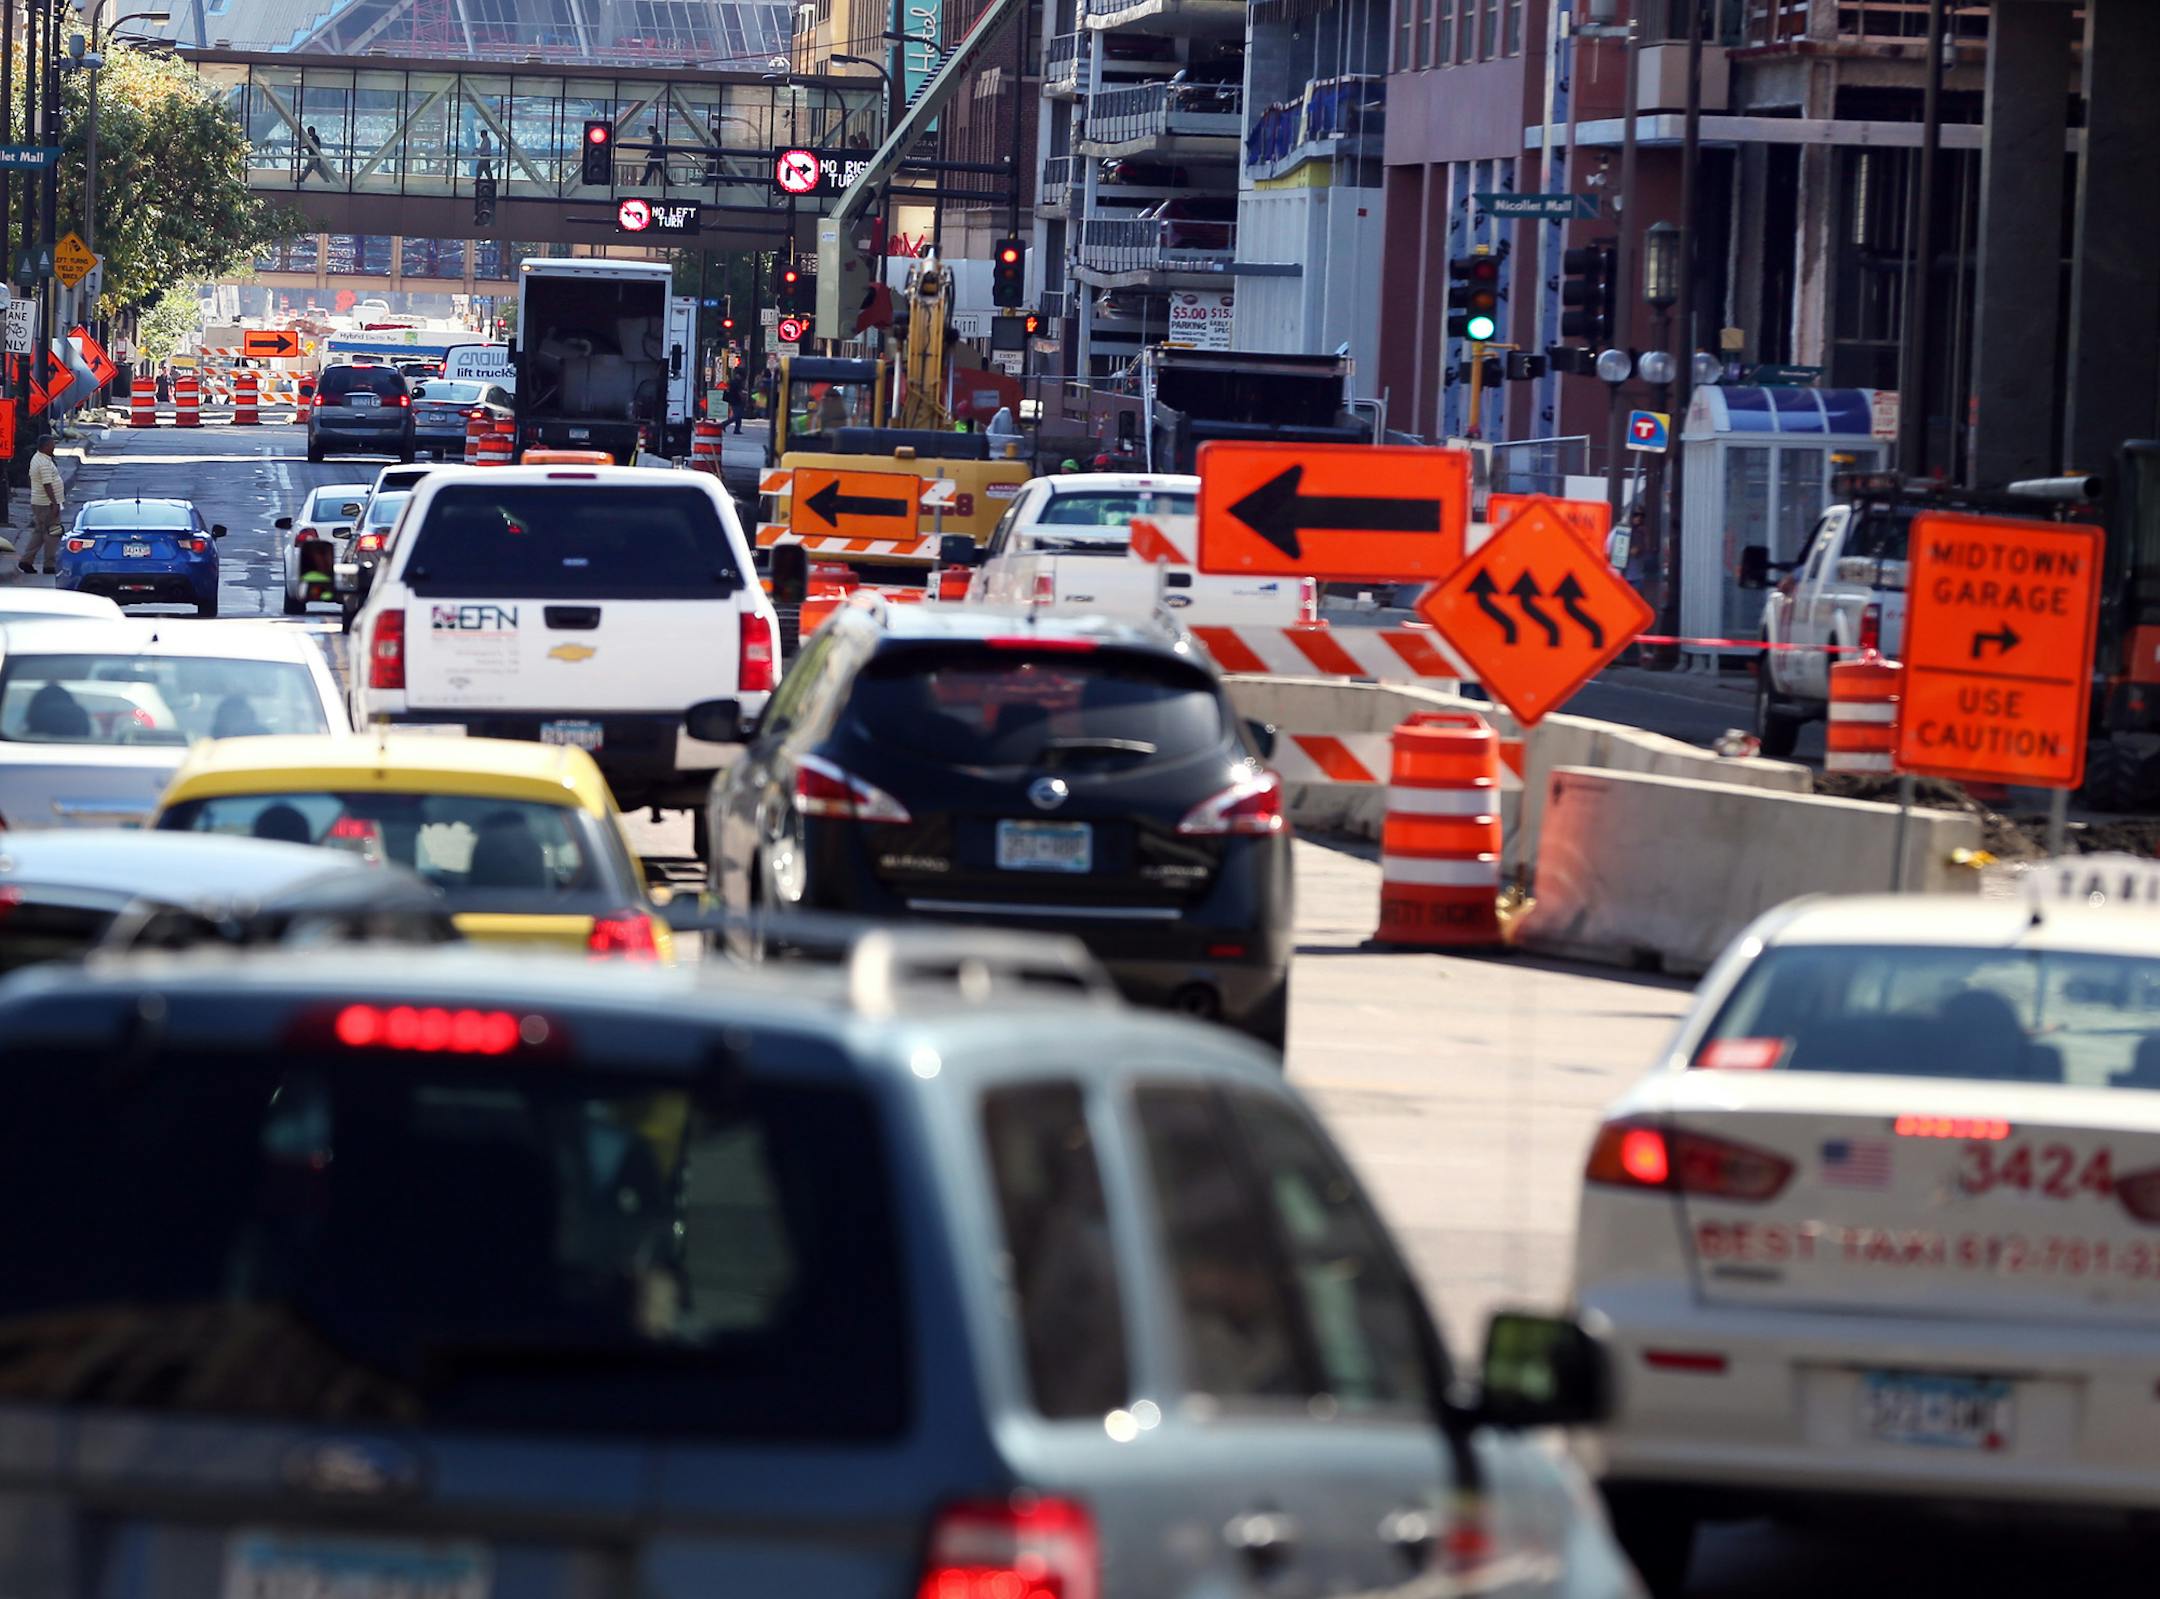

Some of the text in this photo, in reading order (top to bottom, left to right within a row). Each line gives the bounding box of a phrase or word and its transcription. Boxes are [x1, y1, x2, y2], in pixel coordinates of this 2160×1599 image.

[907, 3, 937, 72] Hotel
[20, 151, 44, 162] Mall
[819, 159, 871, 175] NO RIG
[828, 173, 859, 188] TUR
[1494, 199, 1572, 211] Nicollet Mall
[651, 206, 696, 218] NO LEFT
[658, 216, 684, 228] TURN
[9, 301, 26, 310] EFT
[7, 311, 27, 321] ANE
[1172, 305, 1233, 320] $5.00 $15.
[1171, 320, 1207, 330] PARKING
[1214, 326, 1231, 334] SPEC
[340, 332, 364, 341] Hybrid
[5, 340, 26, 351] NLY
[457, 367, 516, 379] lift trucks
[1931, 540, 2080, 578] MIDTOWN
[1932, 577, 2071, 617] GARAGE
[1957, 685, 2024, 719] USE
[1915, 719, 2061, 758] CAUTION
[1960, 1142, 2116, 1199] 3424
[1698, 1218, 1816, 1263] BEST
